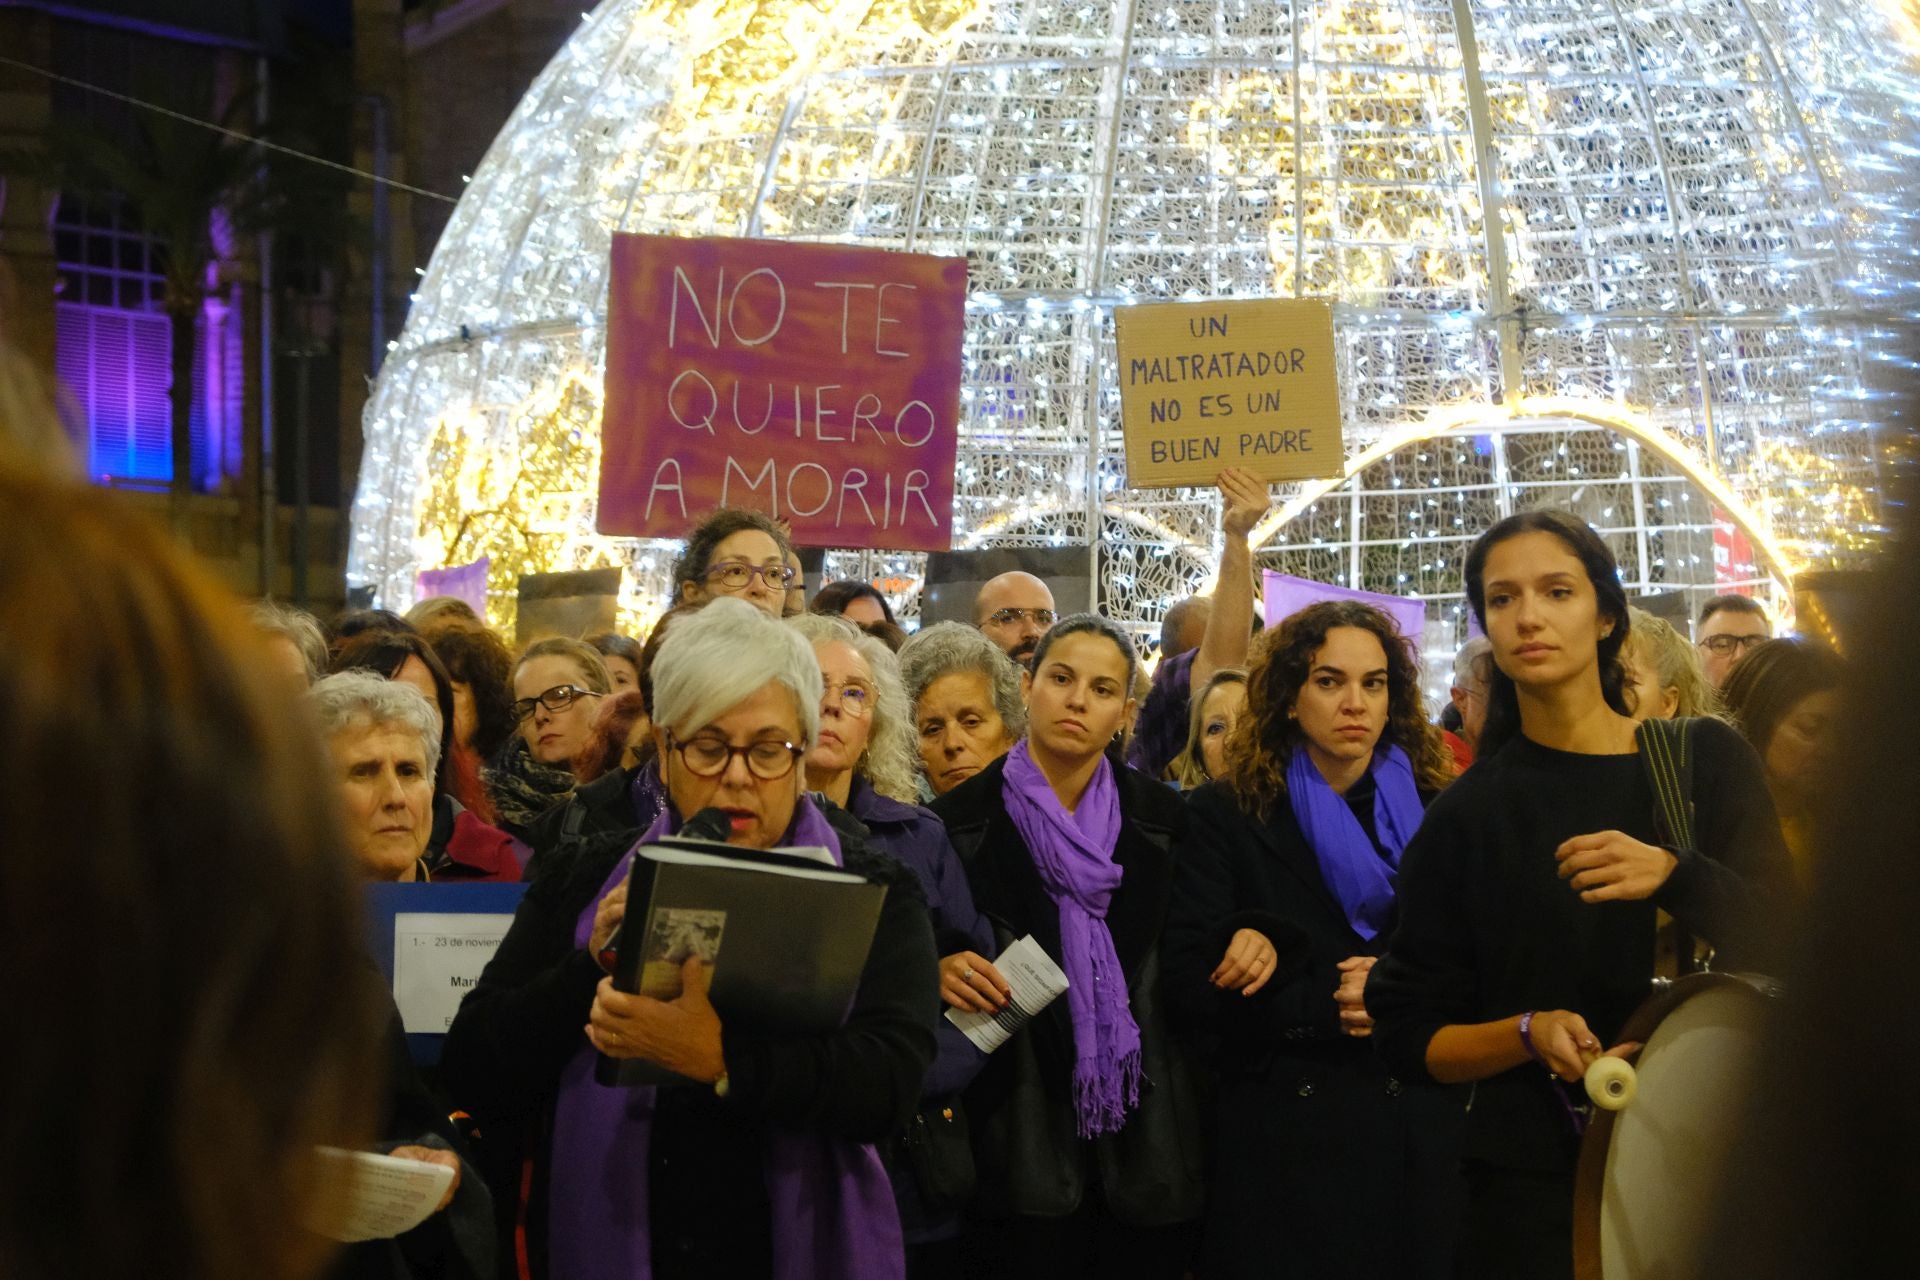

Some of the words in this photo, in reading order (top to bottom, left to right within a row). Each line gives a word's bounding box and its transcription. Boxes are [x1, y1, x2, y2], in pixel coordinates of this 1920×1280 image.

[669, 266, 786, 348] NO
[814, 282, 917, 357] TE
[1190, 314, 1228, 337] UN
[1130, 348, 1305, 385] MALTRATADOR
[668, 369, 935, 447] QUIERO
[1151, 398, 1181, 424] NO
[1199, 394, 1233, 417] ES
[1247, 389, 1281, 414] UN
[1151, 436, 1220, 463] BUEN
[1240, 429, 1312, 456] PADRE
[645, 458, 687, 520] A
[721, 456, 938, 530] MORIR
[434, 937, 448, 947] 23
[450, 937, 463, 947] de
[465, 937, 503, 947] noviem
